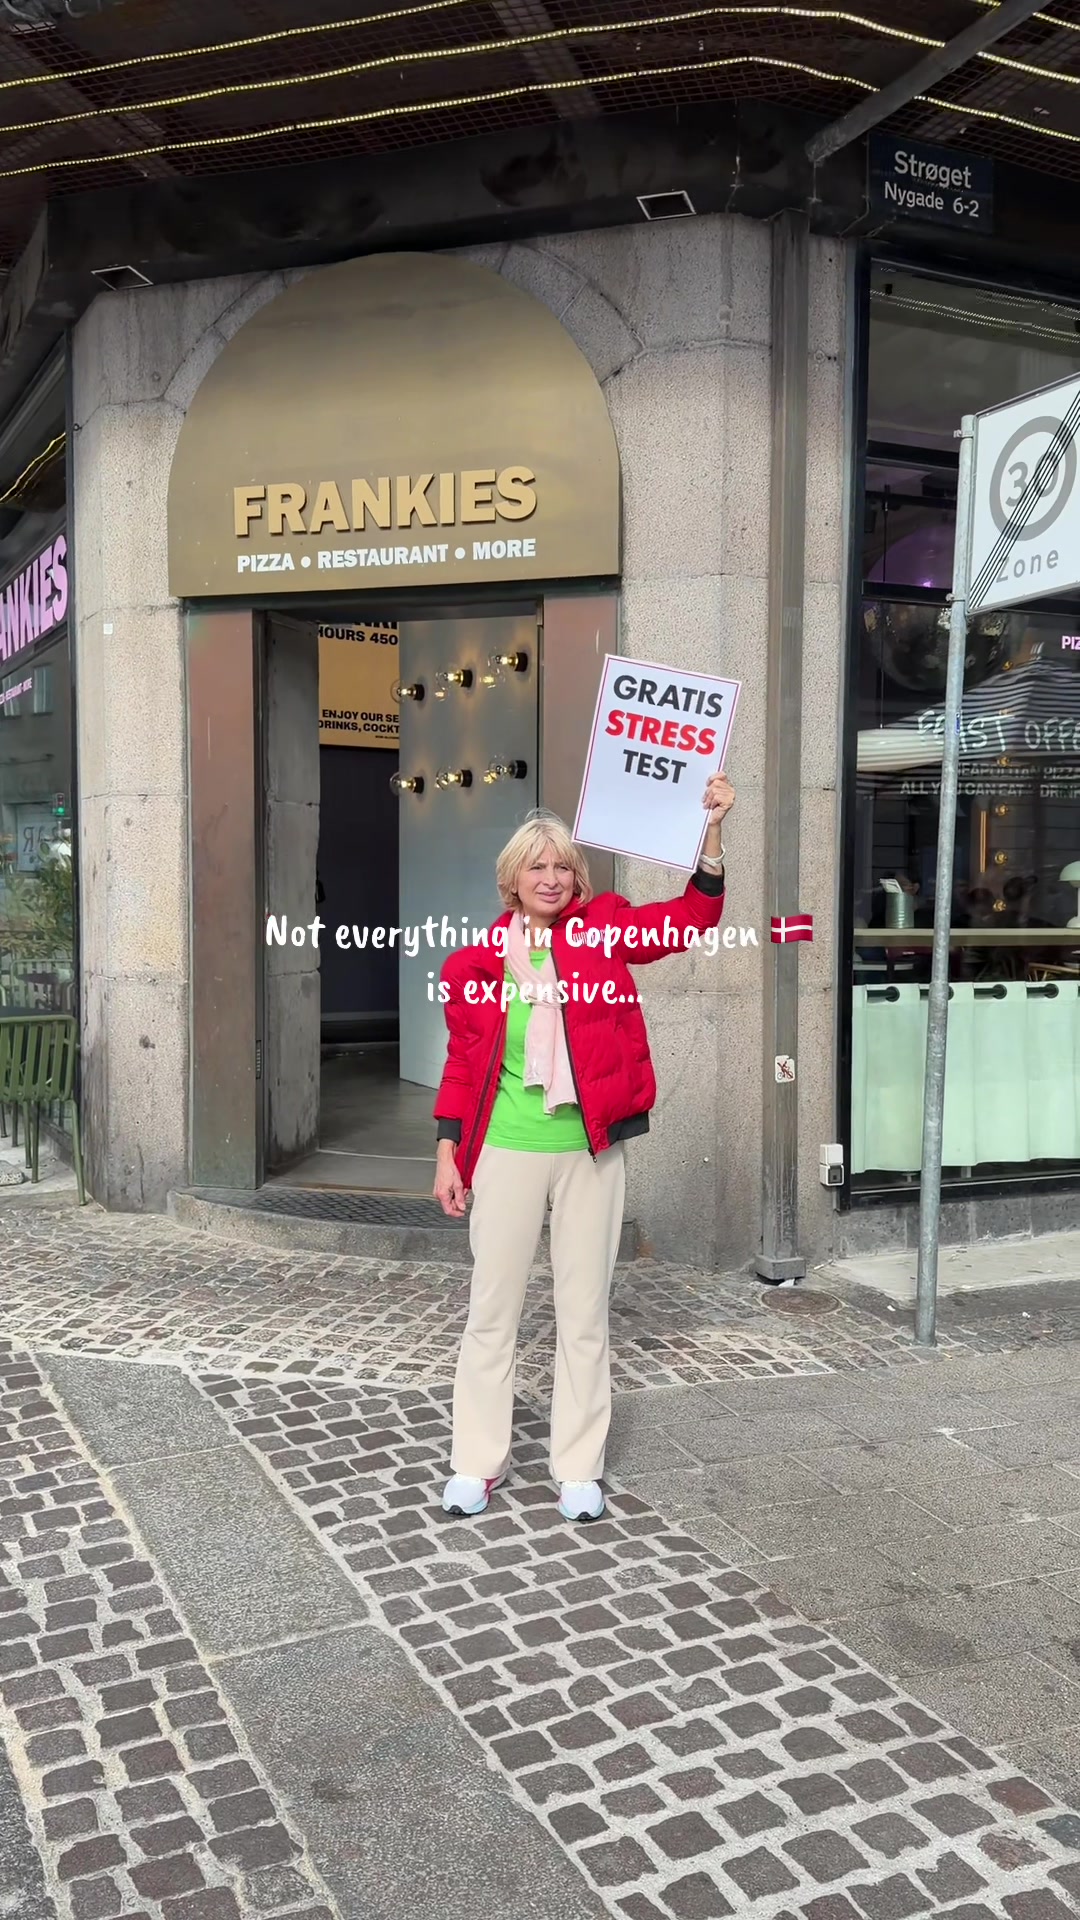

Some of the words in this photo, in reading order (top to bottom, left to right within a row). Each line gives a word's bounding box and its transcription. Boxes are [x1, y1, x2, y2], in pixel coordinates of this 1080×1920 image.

[894, 151, 971, 189] Strøget
[884, 181, 944, 210] Nygade
[953, 197, 979, 217] 6-2
[1005, 453, 1059, 507] 30
[233, 466, 537, 537] FRANKIES
[237, 553, 295, 573] PIZZA
[317, 544, 448, 569] RESTAURANT
[472, 538, 537, 561] MORE
[369, 632, 399, 646] 450
[613, 675, 724, 718] GRATIS
[322, 709, 358, 720] ENJOY
[360, 712, 384, 722] OUR
[605, 709, 717, 755] STRESS
[623, 749, 687, 784] TEST
[900, 781, 929, 795] ALL
